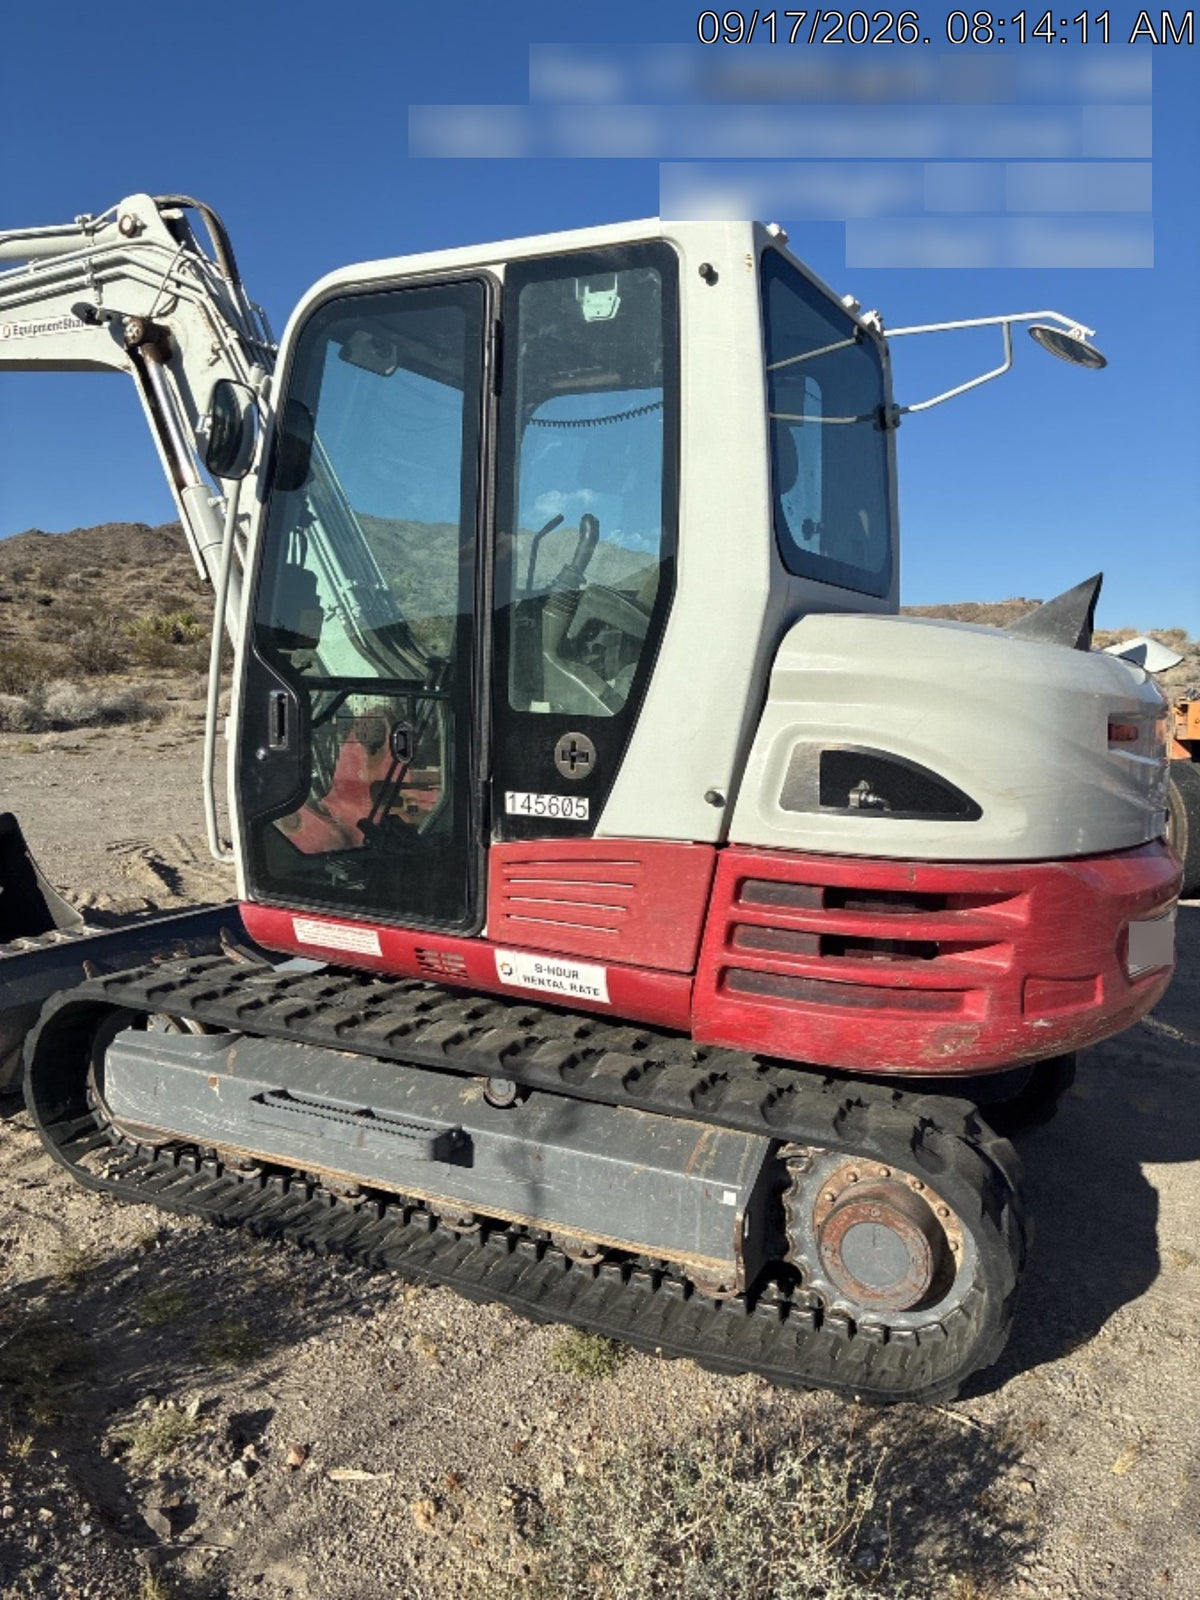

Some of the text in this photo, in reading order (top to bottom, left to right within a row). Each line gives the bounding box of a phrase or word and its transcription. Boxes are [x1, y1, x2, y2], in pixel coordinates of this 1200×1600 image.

[13, 317, 86, 336] EquipmentShar
[507, 793, 588, 818] 145605
[534, 963, 580, 980] 8-HOUR
[521, 974, 601, 997] RENTAL RATE
